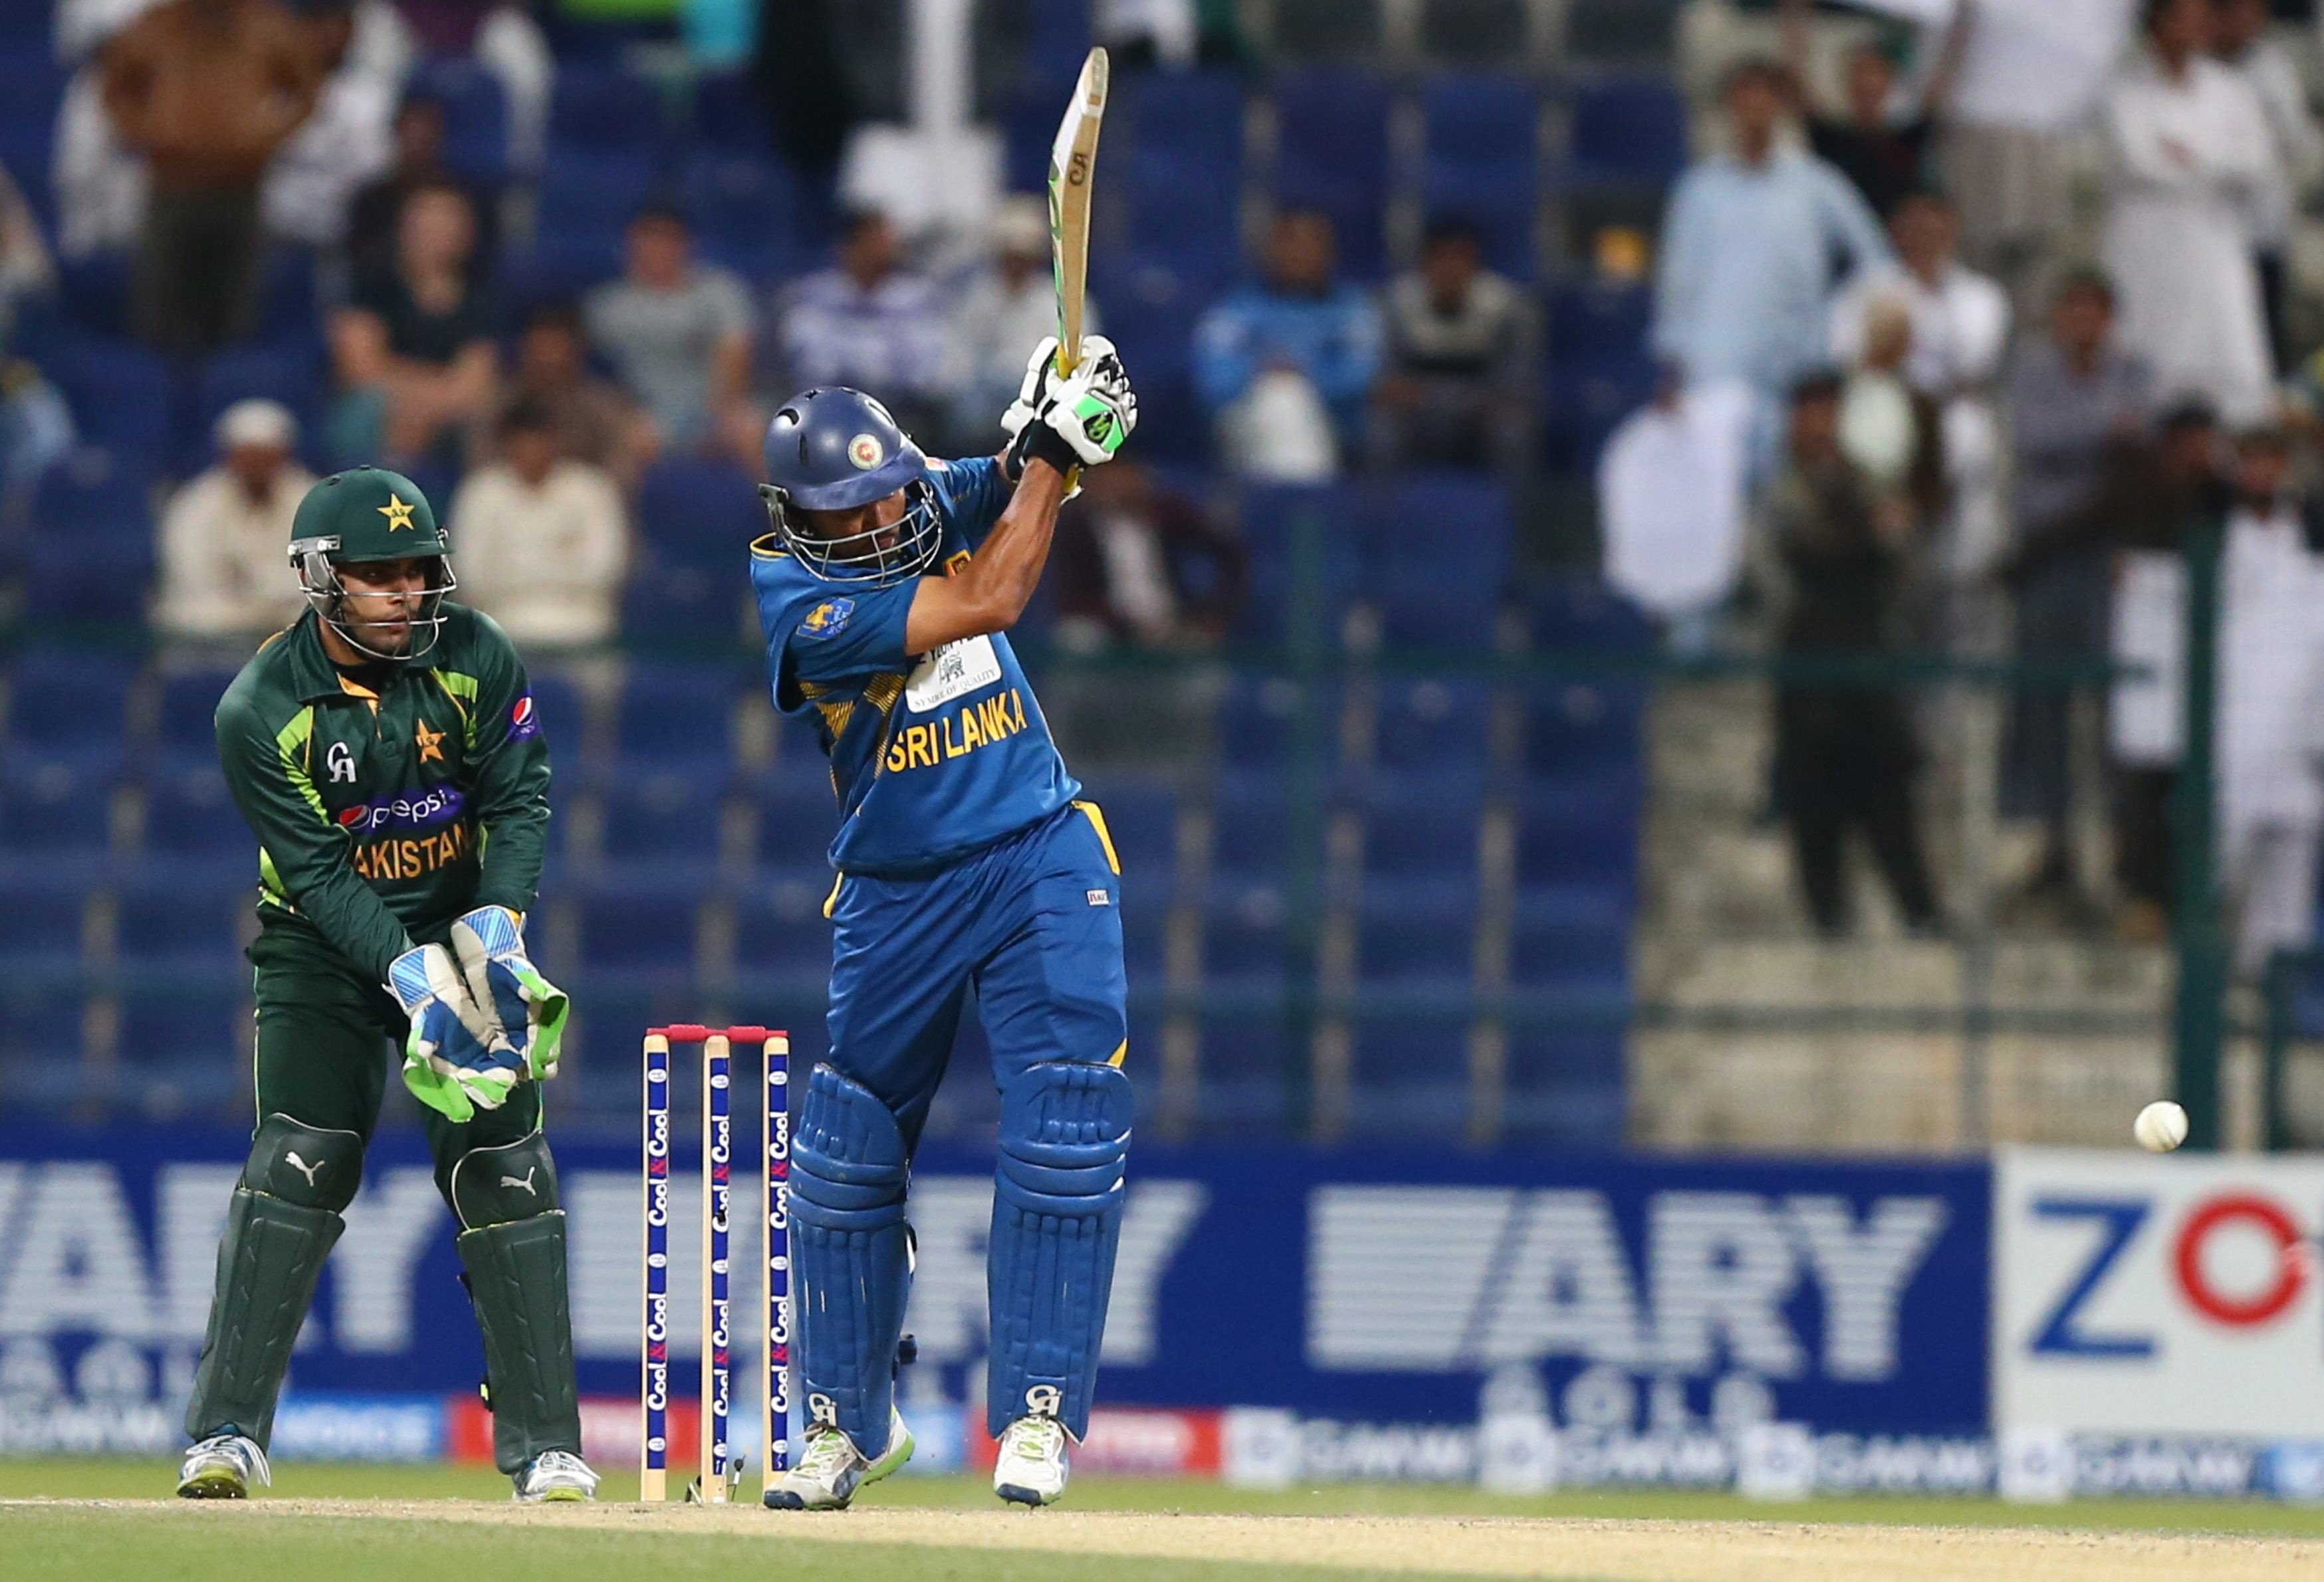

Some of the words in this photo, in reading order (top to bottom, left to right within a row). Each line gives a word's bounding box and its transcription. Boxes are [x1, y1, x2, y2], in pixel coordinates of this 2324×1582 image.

[959, 669, 996, 691] QUALITY
[886, 722, 939, 772] SRI
[942, 688, 1027, 758] LANKA
[327, 741, 356, 783] CA
[371, 788, 447, 829] pepsi
[352, 817, 471, 879] AKISTAN
[647, 1109, 667, 1157] Cool
[711, 1115, 730, 1163] Cool
[769, 1111, 789, 1159] Cool
[647, 1179, 667, 1226] Cool
[769, 1181, 789, 1229] Cool
[1477, 1185, 1951, 1383] ARY
[647, 1293, 667, 1341] Cool
[713, 1299, 729, 1347] Cool
[770, 1296, 789, 1344] Cool
[647, 1362, 667, 1411] Cool
[713, 1369, 729, 1416] Cool
[770, 1365, 789, 1412] Cool
[809, 1393, 838, 1426] CA
[1025, 1385, 1062, 1416] CA
